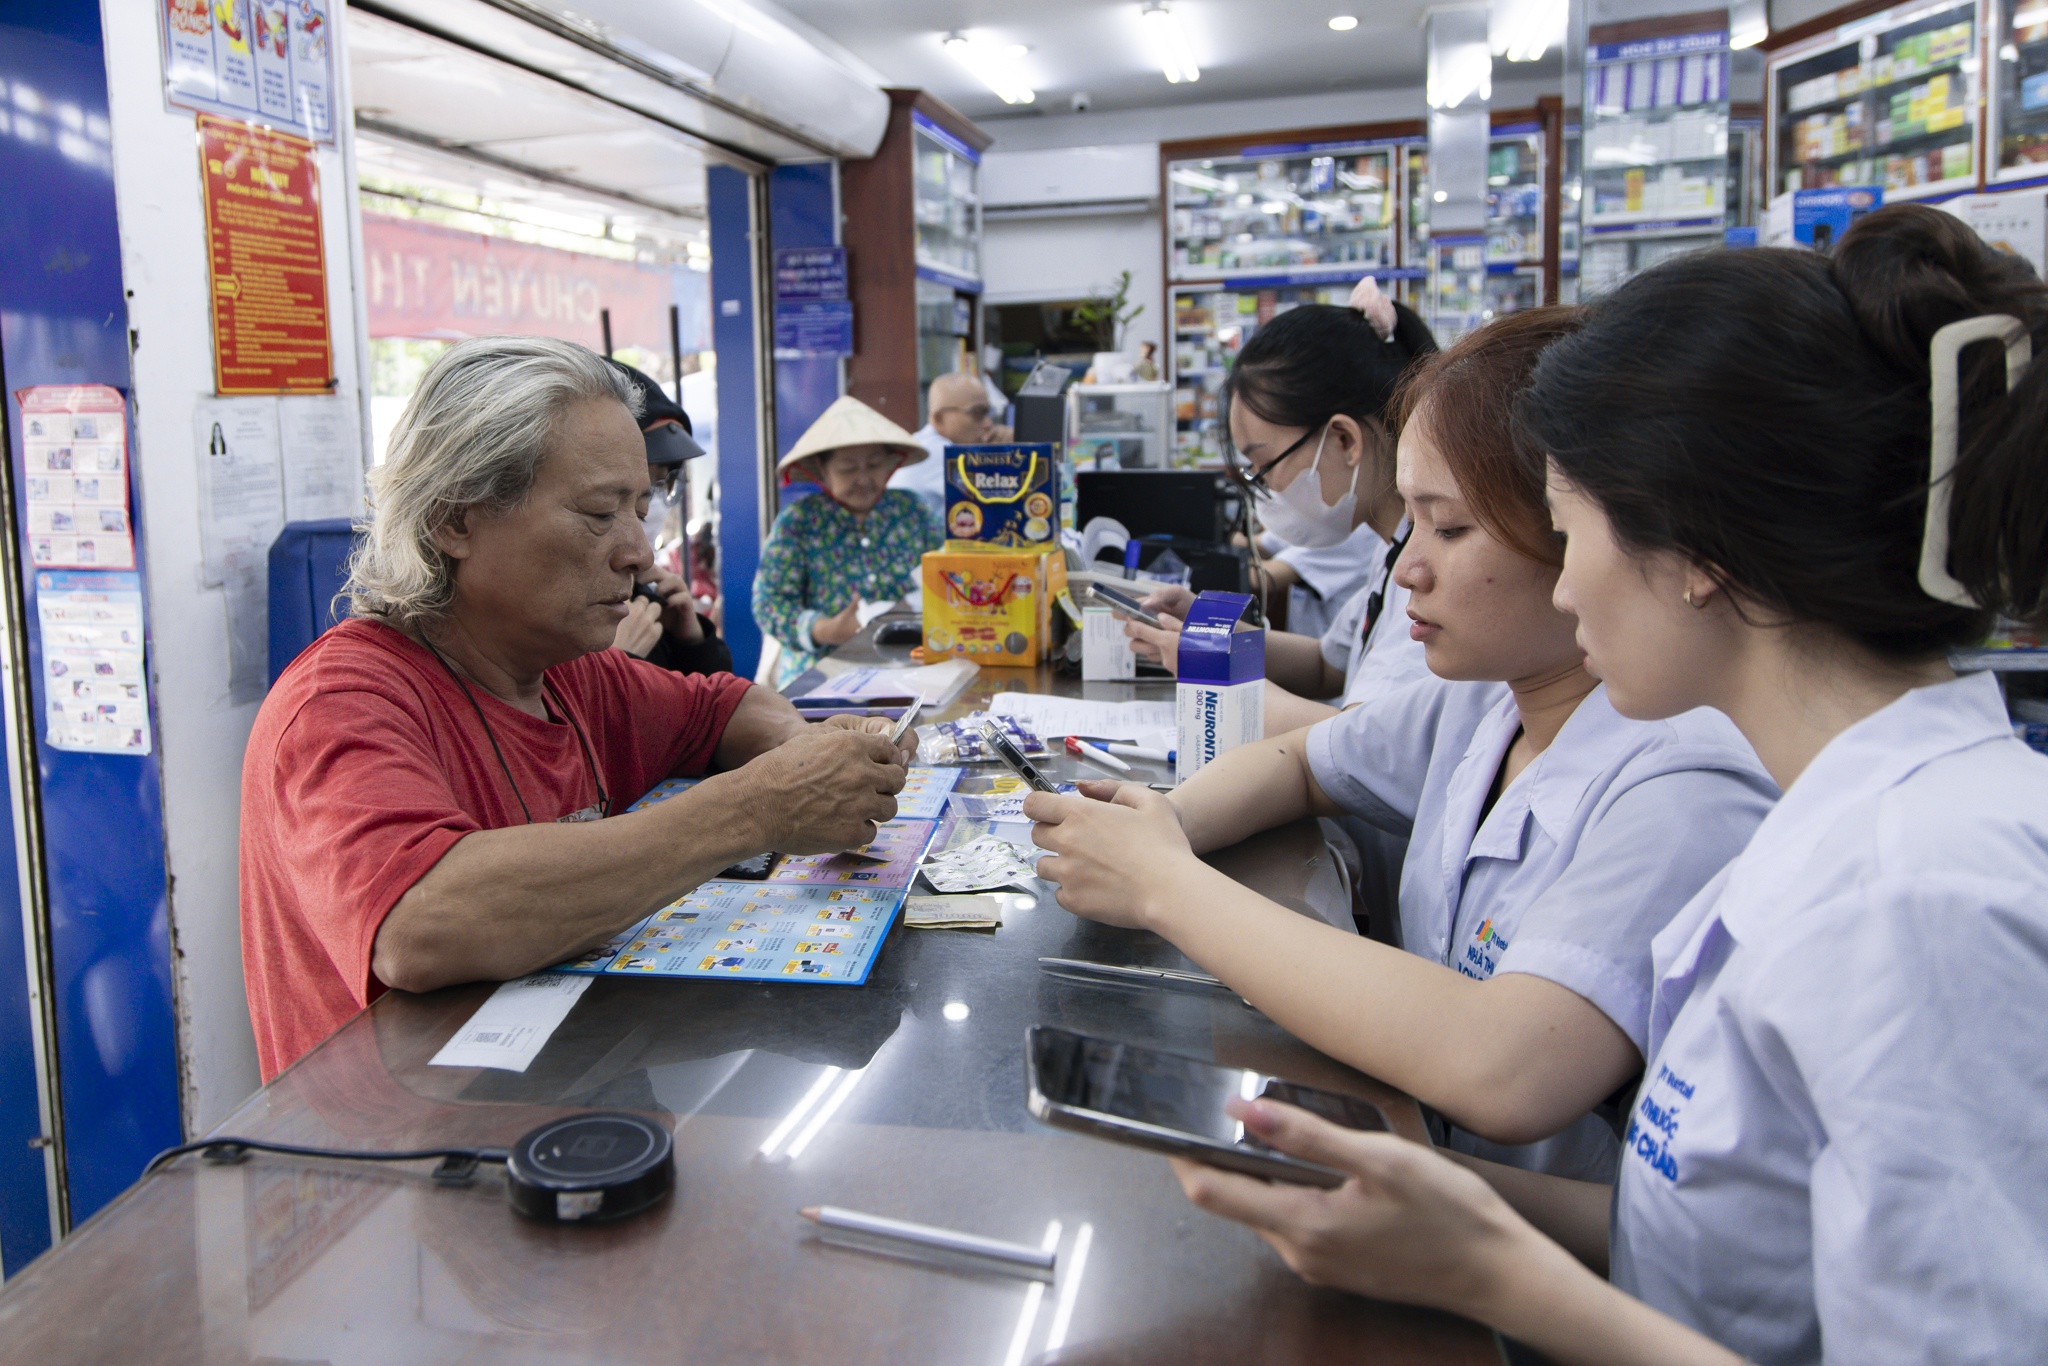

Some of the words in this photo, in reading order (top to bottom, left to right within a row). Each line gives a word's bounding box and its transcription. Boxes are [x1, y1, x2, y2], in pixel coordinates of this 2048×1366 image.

[975, 473, 1018, 488] Relax
[1196, 689, 1204, 706] 300
[1195, 707, 1203, 720] mg
[1467, 944, 1483, 968] NHÀ
